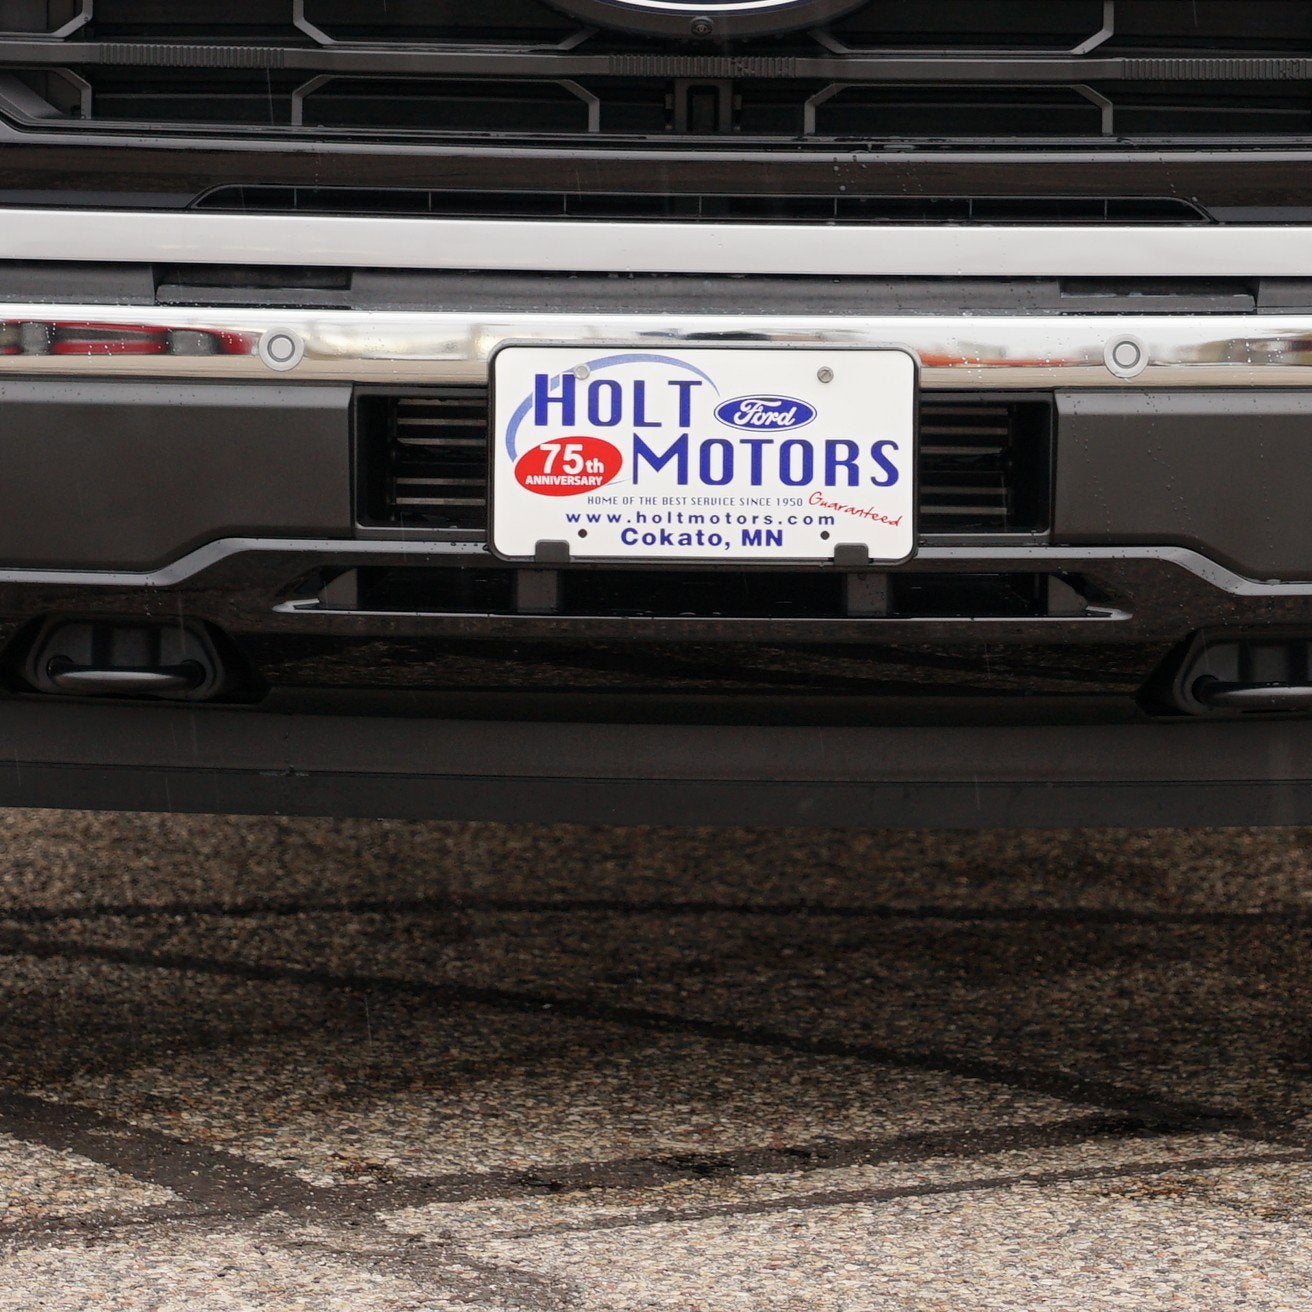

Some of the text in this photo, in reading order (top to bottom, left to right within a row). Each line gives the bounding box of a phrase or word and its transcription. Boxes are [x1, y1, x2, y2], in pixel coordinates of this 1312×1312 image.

[534, 374, 702, 427] HOLT
[733, 399, 796, 426] Ford
[540, 444, 604, 474] 75th
[633, 433, 899, 487] MOTORS
[525, 475, 603, 486] ANNIVERSARY
[588, 496, 803, 506] HOME OF THE BEST SERVICE SINCE 1950
[808, 491, 903, 527] Guaranteed
[565, 511, 835, 525] www.holtmotors.com
[621, 527, 783, 550] Cokato, MN
